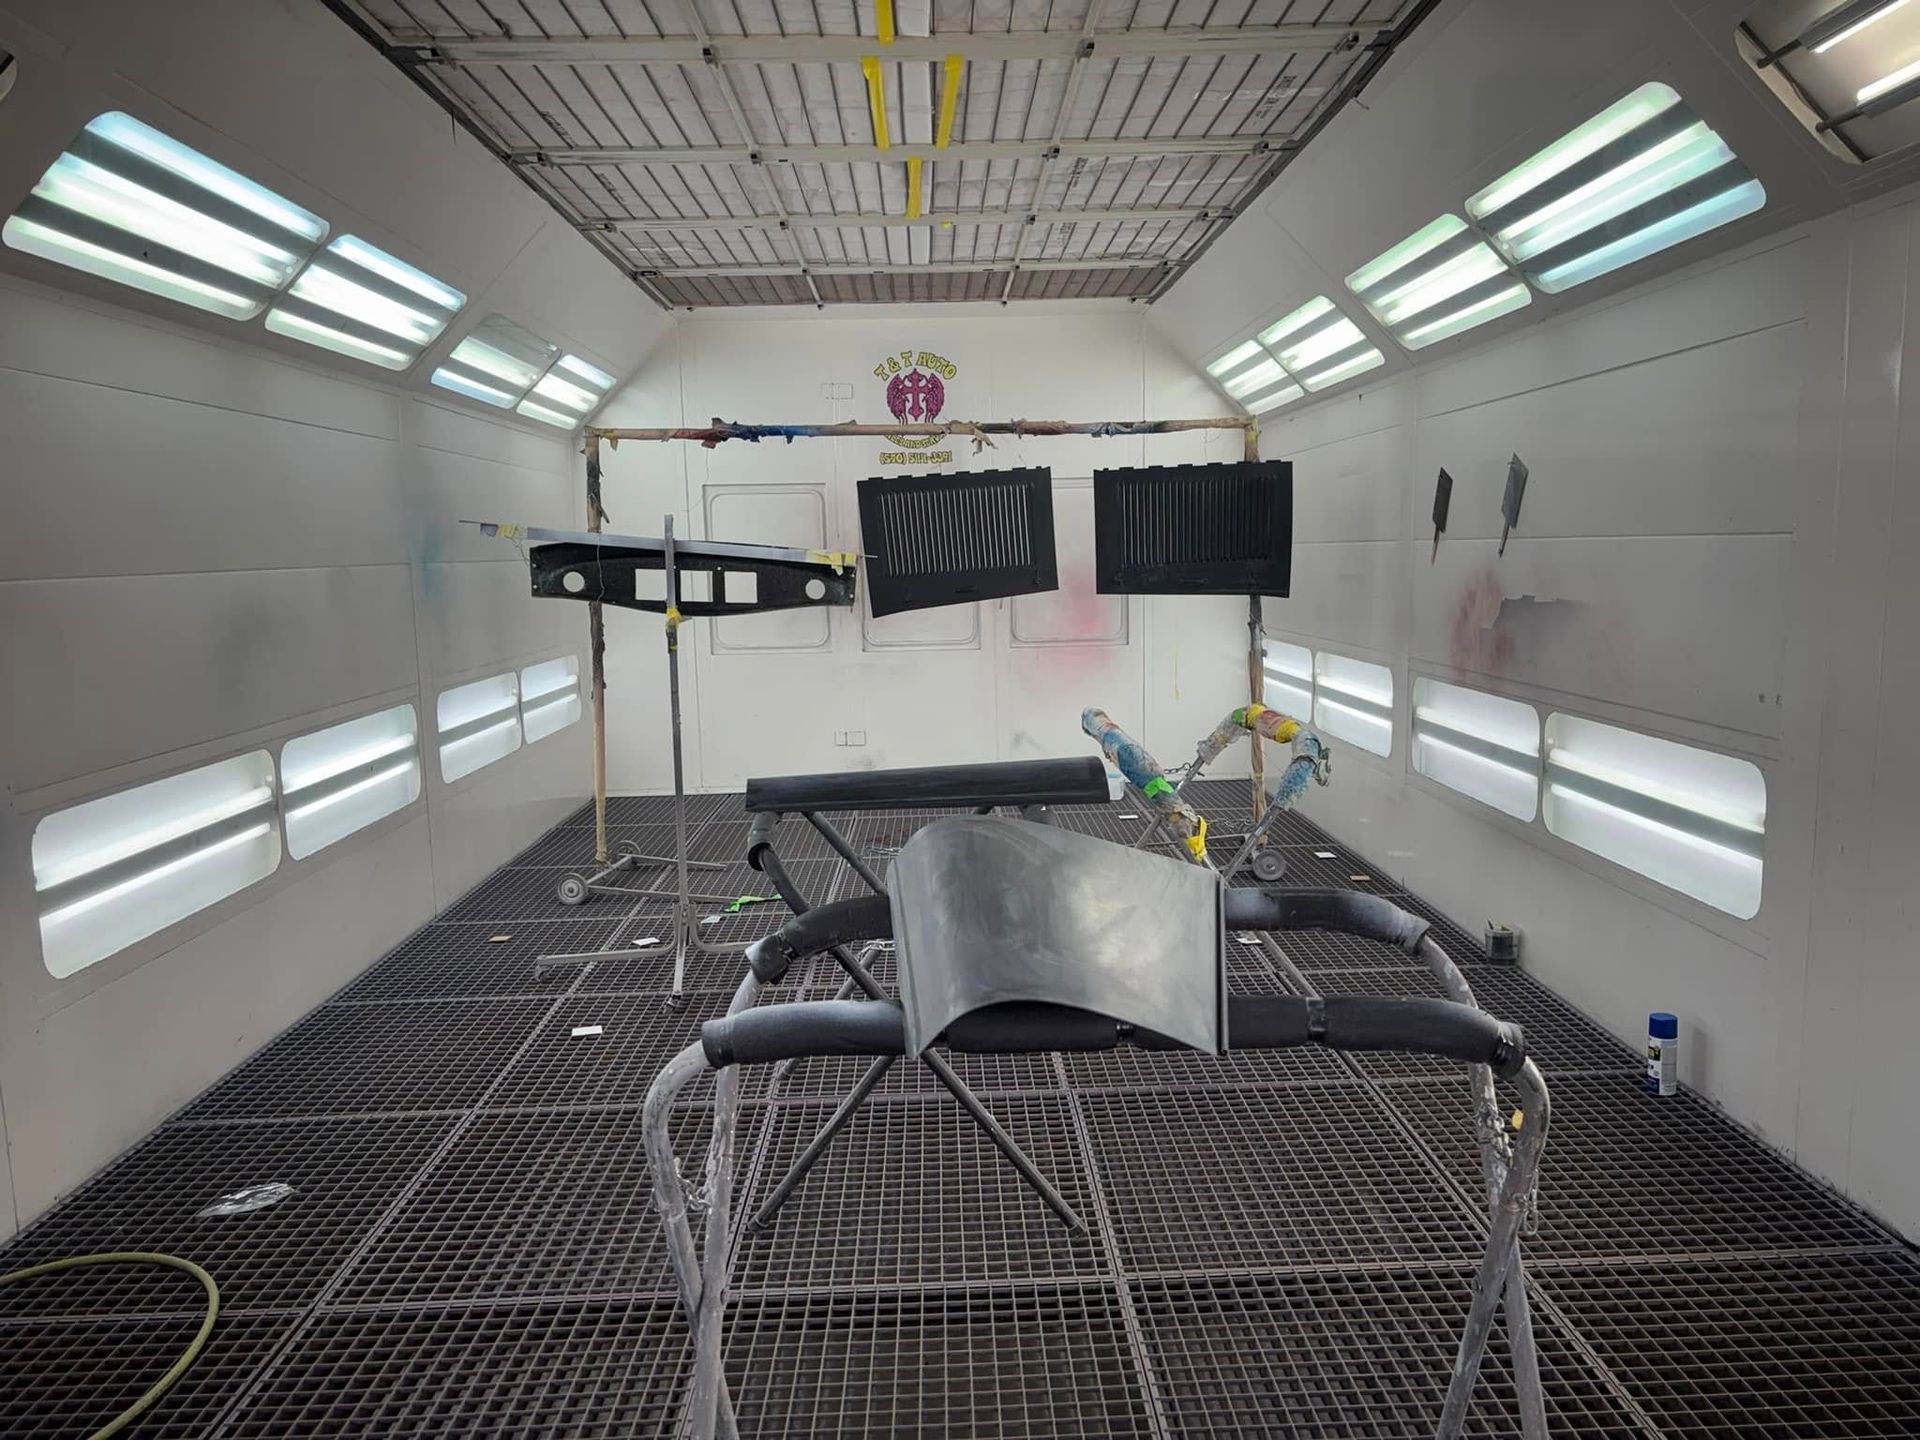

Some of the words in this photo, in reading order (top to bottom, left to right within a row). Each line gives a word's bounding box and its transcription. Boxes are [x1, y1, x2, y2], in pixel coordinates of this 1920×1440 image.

[874, 363, 889, 381] T
[887, 357, 901, 373] &
[900, 350, 912, 367] T
[916, 352, 957, 380] AUTO
